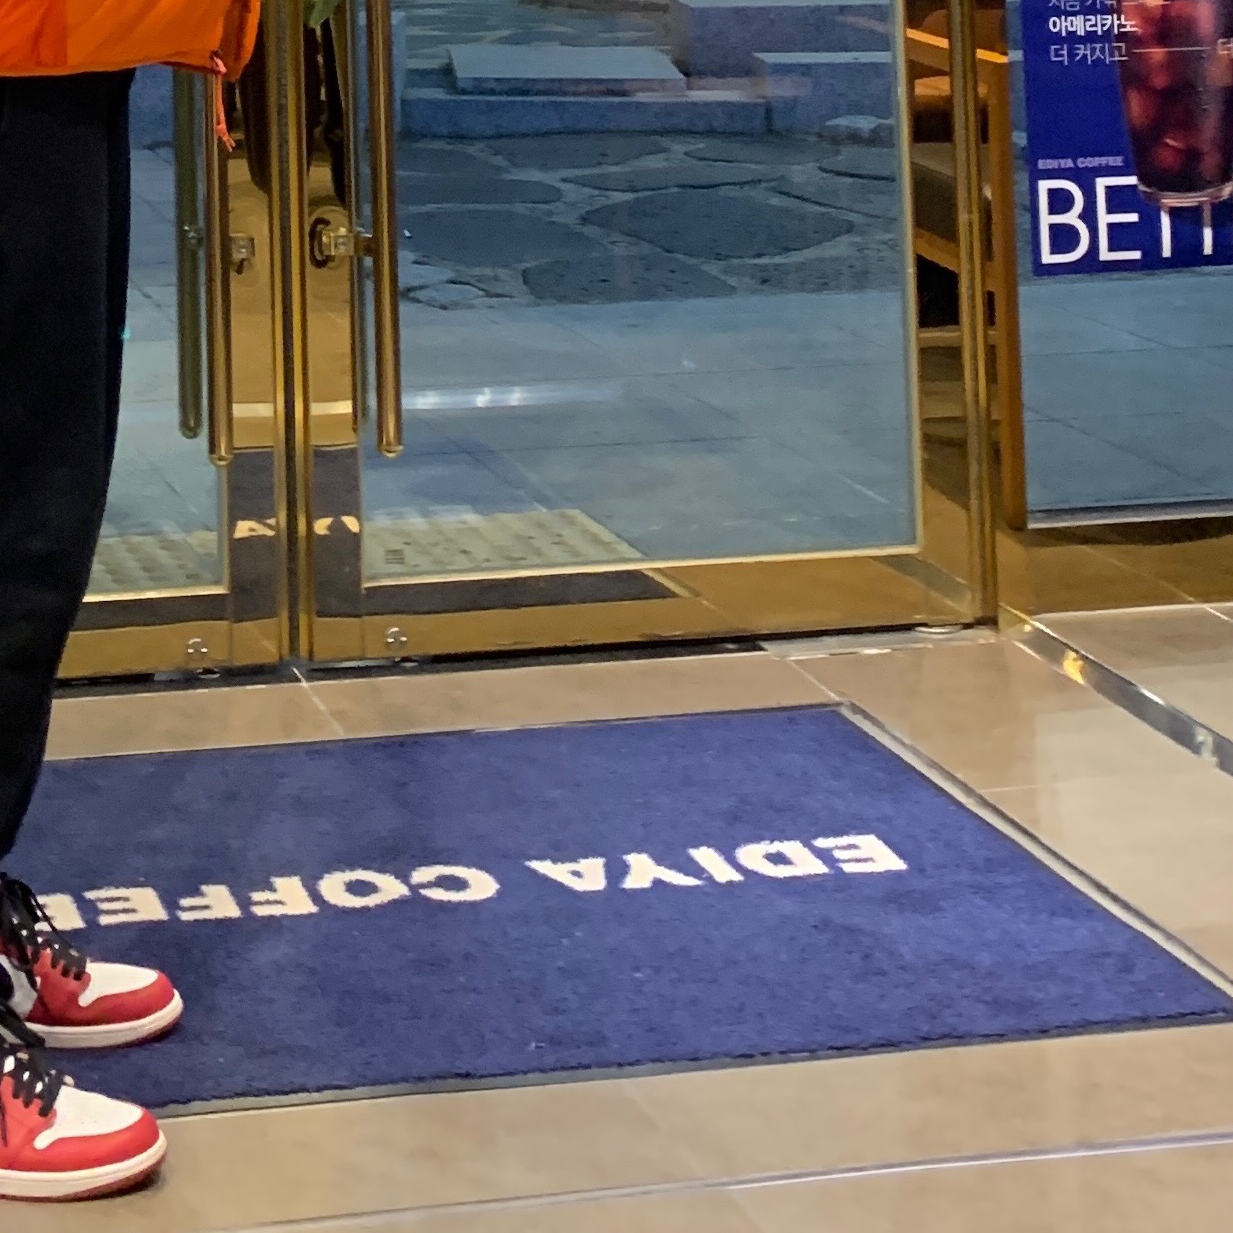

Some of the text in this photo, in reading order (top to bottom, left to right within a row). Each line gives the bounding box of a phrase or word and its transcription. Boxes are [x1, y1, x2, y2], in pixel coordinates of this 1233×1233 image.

[1050, 44, 1068, 66] 더
[1074, 42, 1129, 66] 커지고
[1037, 156, 1125, 170] EDIYA COFFEE
[523, 833, 909, 893] EDIYA
